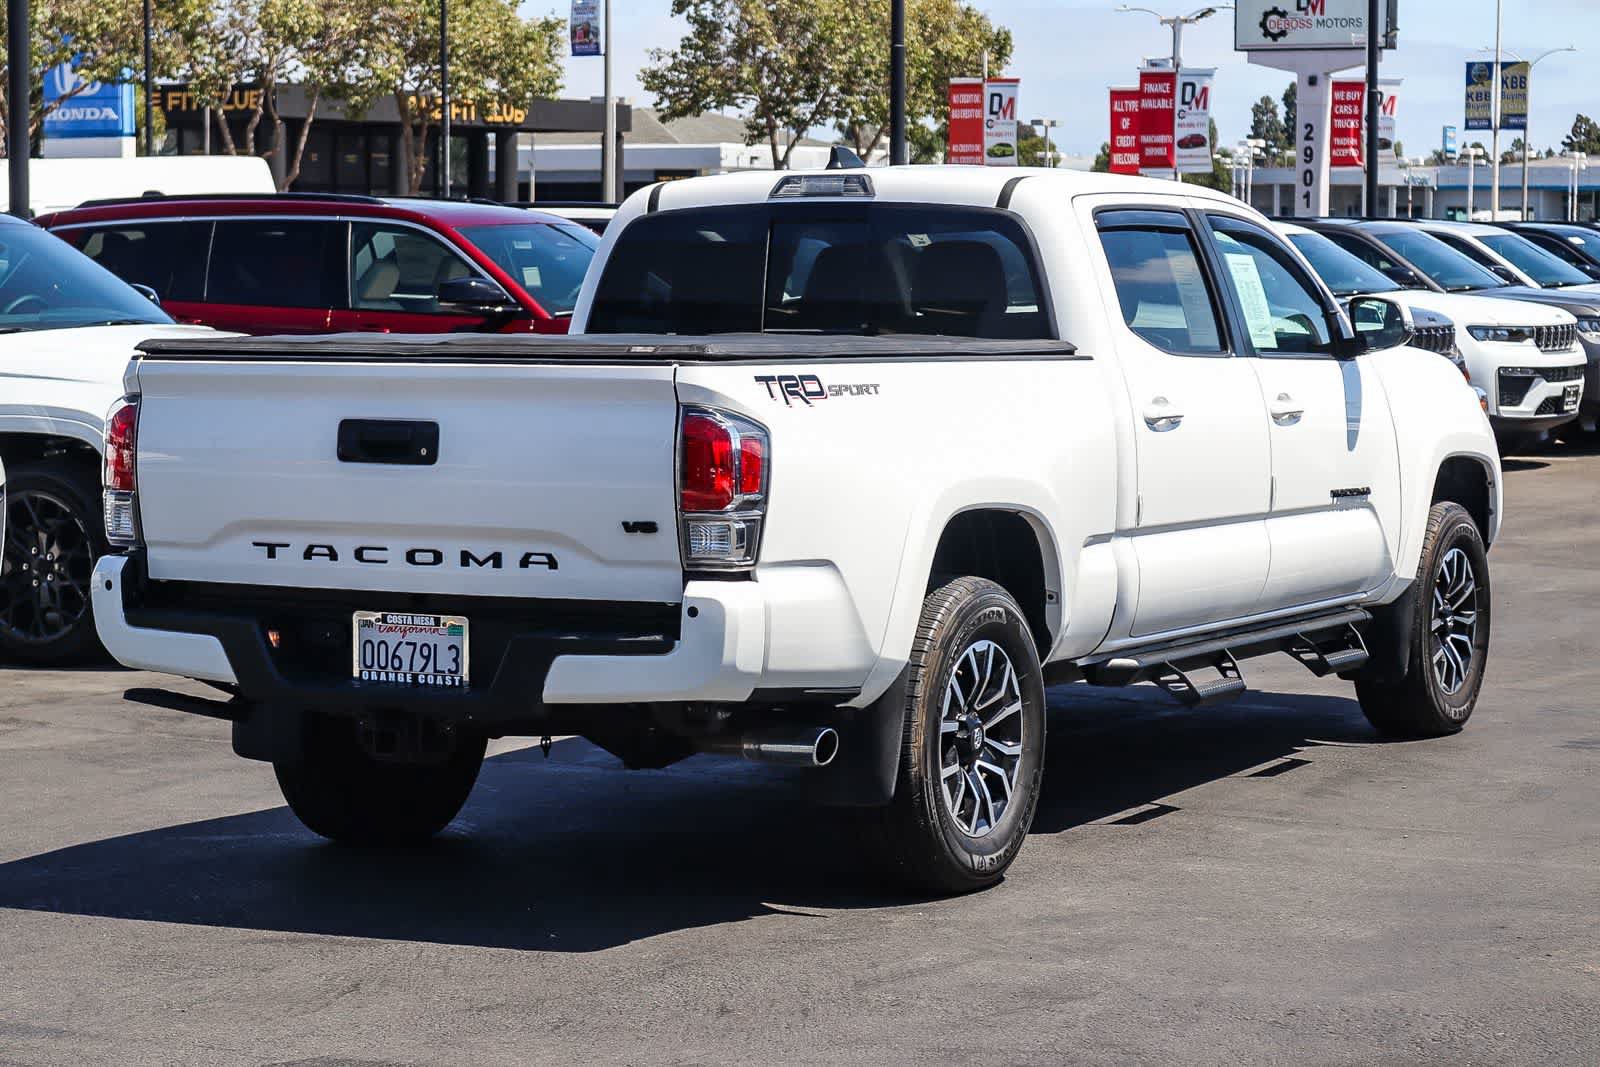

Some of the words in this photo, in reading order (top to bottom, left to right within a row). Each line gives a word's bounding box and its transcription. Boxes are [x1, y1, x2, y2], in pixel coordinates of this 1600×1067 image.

[1268, 18, 1313, 30] DEBOSS
[1316, 17, 1363, 29] MOTORS
[1144, 82, 1171, 94] FINANCE
[1501, 74, 1528, 89] KBB
[1181, 81, 1209, 111] DM
[989, 92, 1016, 121] DM
[1140, 98, 1174, 109] AVAILABLE
[1334, 104, 1352, 115] CARS
[1121, 118, 1131, 130] OF
[1334, 118, 1360, 129] TRUCKS
[1116, 136, 1136, 147] CREDIT
[1114, 153, 1140, 165] WELCOME
[1303, 123, 1314, 208] 2901
[754, 375, 828, 408] TRD
[828, 384, 880, 397] SPORT
[252, 541, 559, 570] TACOMA
[386, 614, 412, 625] COSTA
[413, 616, 435, 626] MESA
[362, 639, 460, 674] 00679L3
[361, 671, 413, 683] ORANGE
[418, 674, 461, 686] COAST
